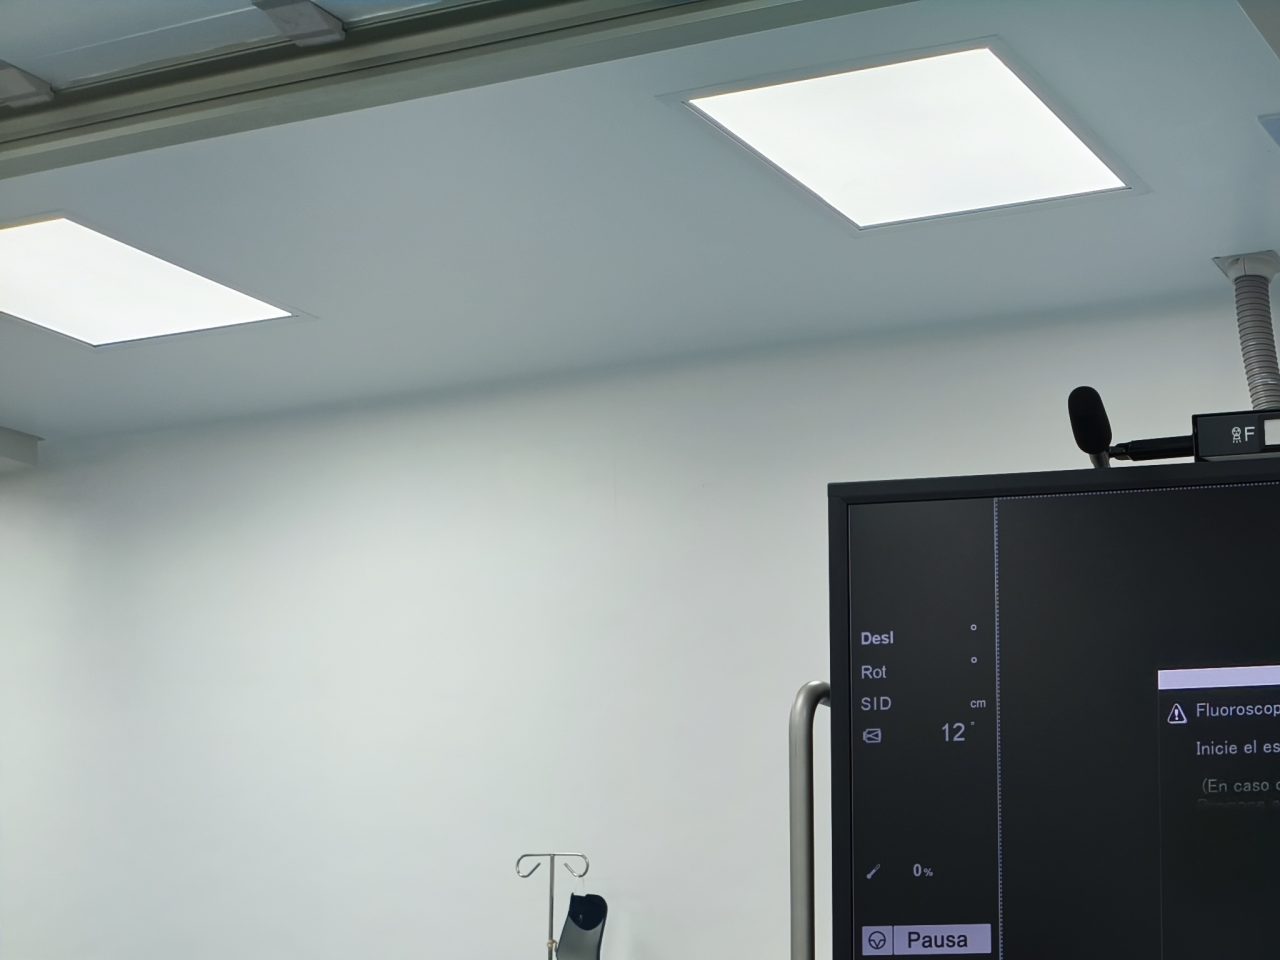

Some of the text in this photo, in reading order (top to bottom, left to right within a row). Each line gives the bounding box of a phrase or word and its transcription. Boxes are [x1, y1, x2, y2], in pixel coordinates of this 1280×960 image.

[1244, 426, 1255, 441] F
[861, 631, 894, 645] Desl
[861, 665, 887, 679] Rot
[861, 697, 986, 711] SID cm
[1196, 740, 1237, 755] Inicie
[1243, 740, 1257, 754] el
[1202, 777, 1228, 795] (En
[1233, 780, 1270, 793] caso
[912, 863, 933, 877] 0%
[907, 931, 968, 948] Pausa
